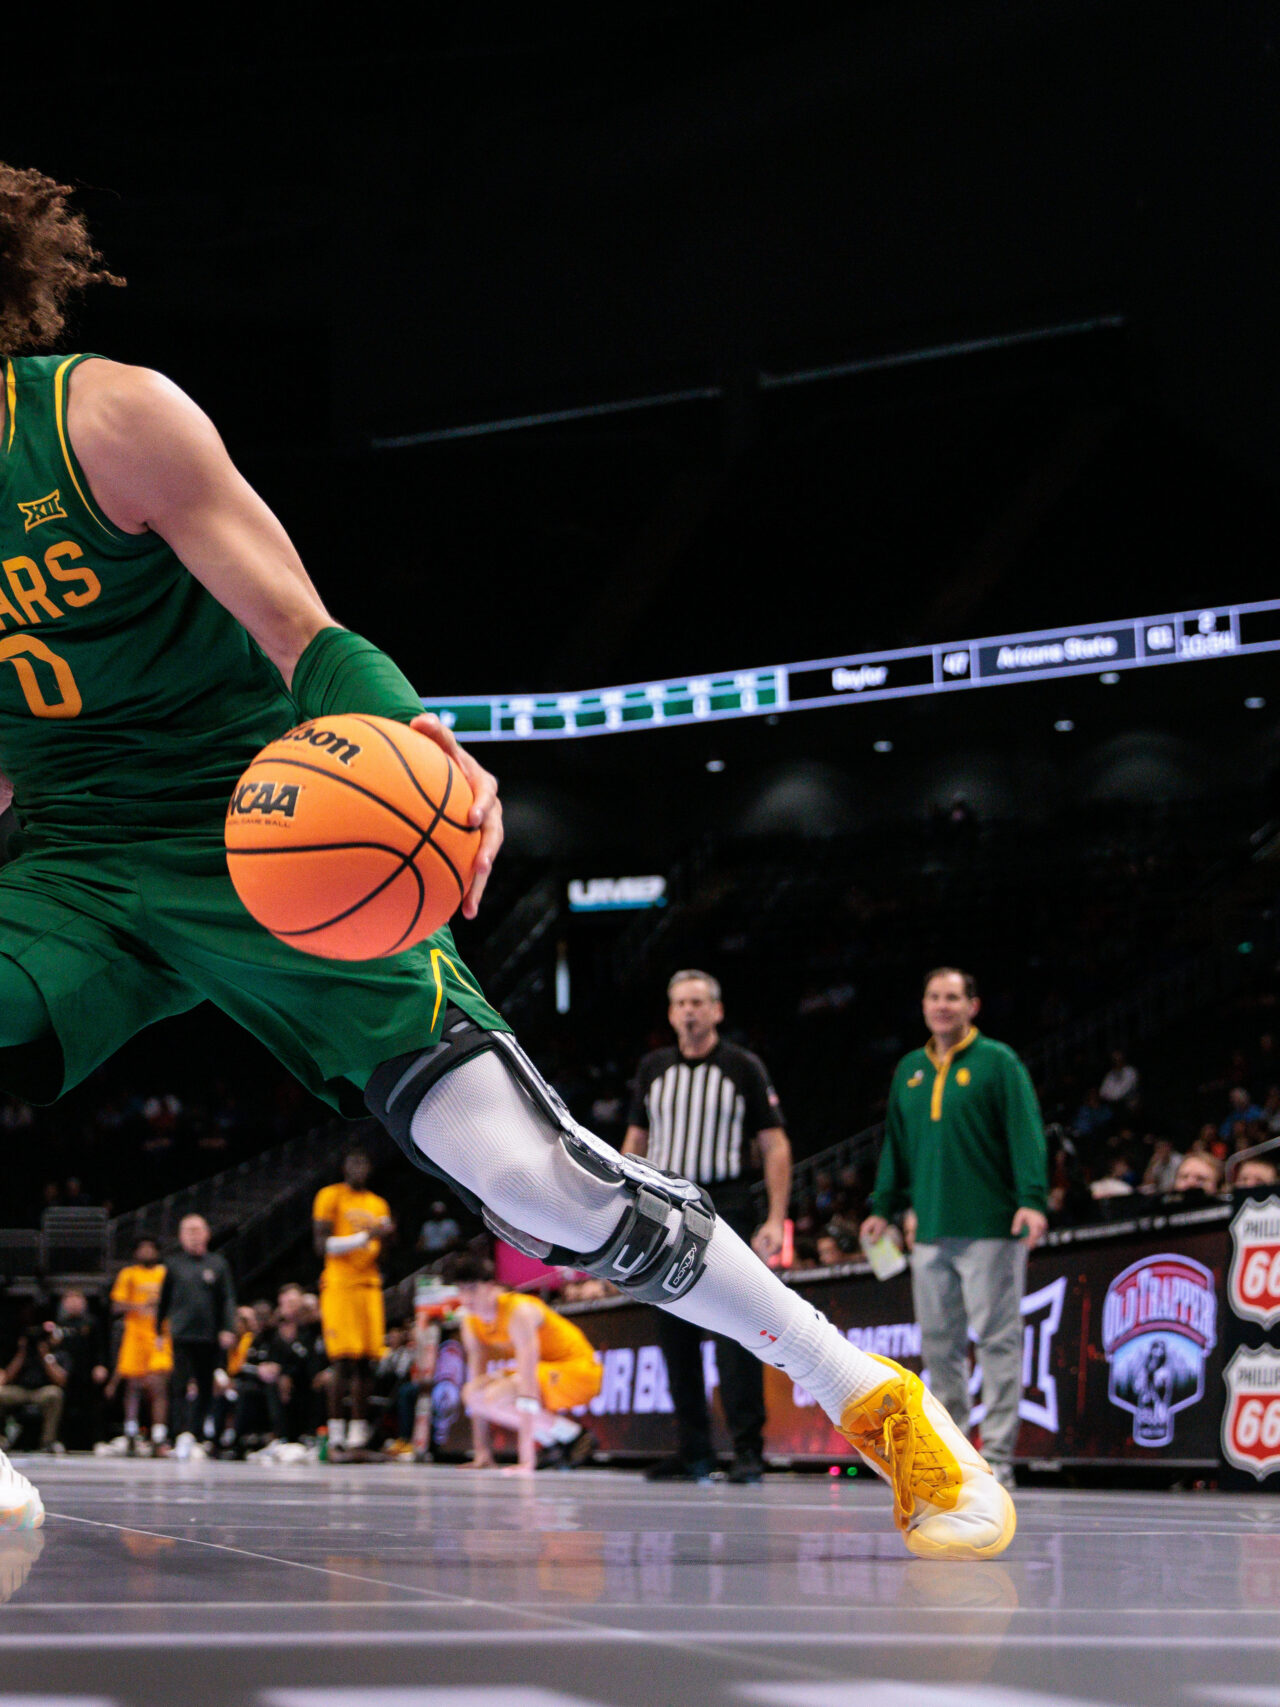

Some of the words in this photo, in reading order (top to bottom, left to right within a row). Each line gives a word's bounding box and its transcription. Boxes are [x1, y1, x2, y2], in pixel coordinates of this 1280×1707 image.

[996, 643, 1065, 670] Arizona
[1064, 636, 1118, 661] State
[1236, 1399, 1280, 1449] 66
